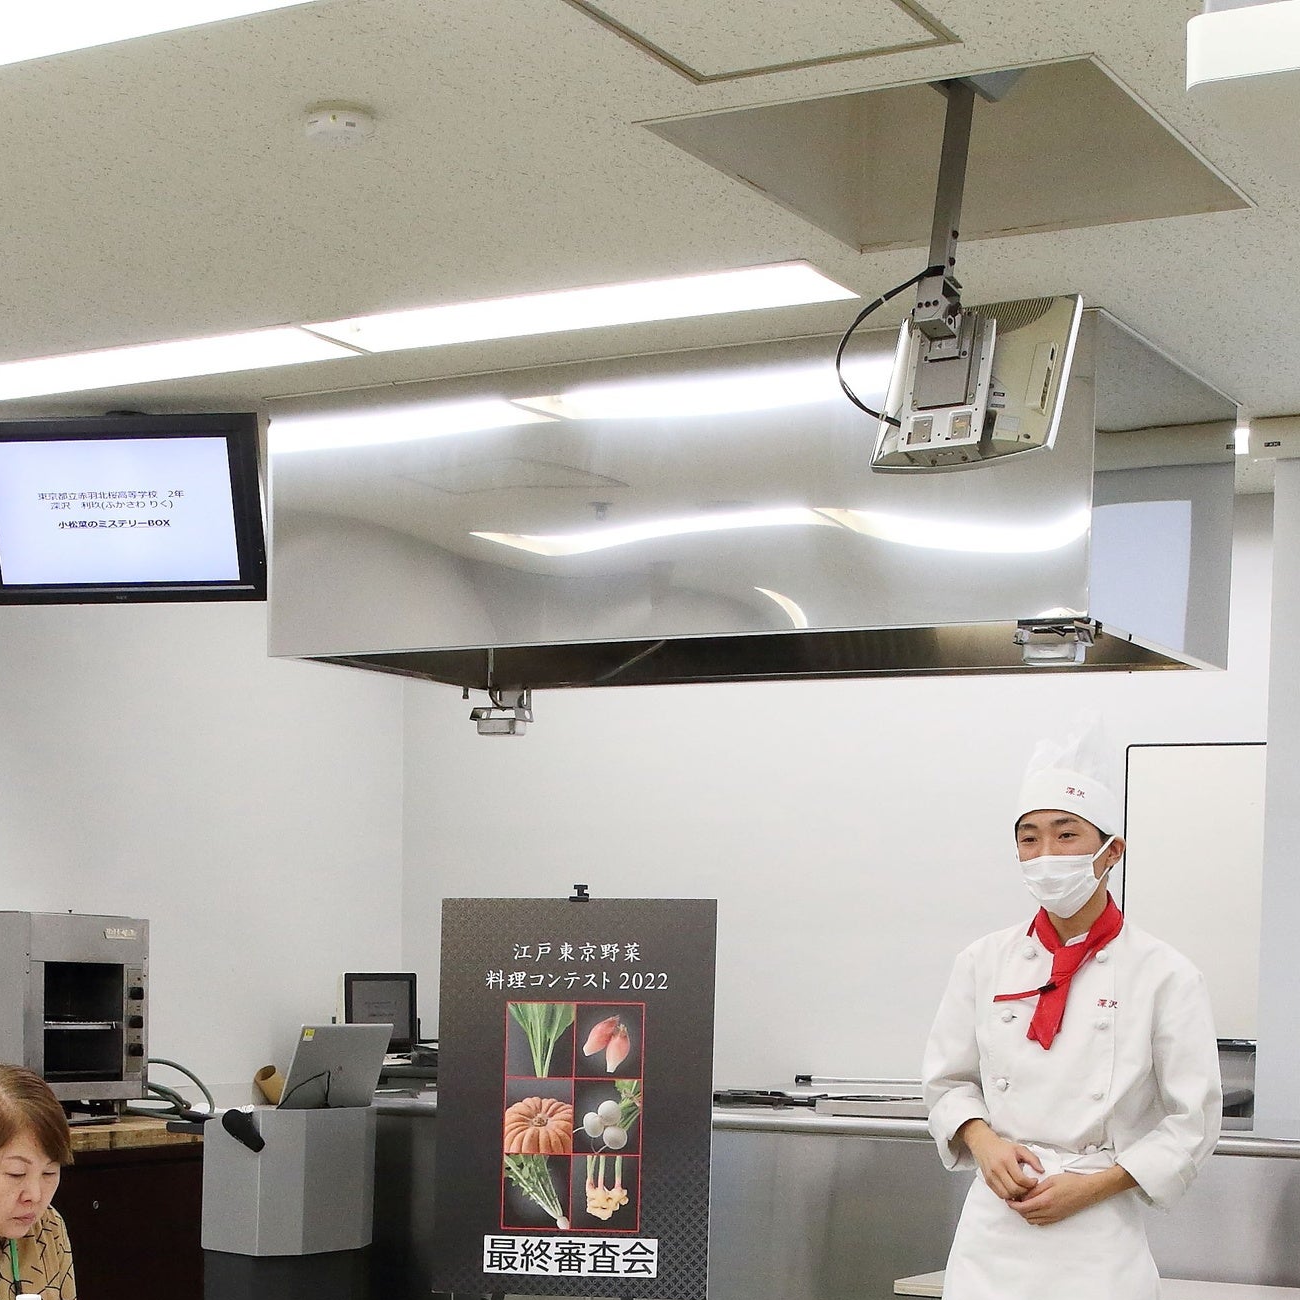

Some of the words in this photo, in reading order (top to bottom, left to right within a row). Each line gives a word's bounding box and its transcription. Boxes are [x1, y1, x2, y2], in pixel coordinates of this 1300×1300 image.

[38, 490, 158, 500] 東京都立赤羽北桜高等学校
[168, 490, 184, 498] 2年
[50, 501, 71, 510] 深沢
[149, 500, 173, 509] りく)
[58, 519, 171, 528] 小松菜のミステリーBOX
[513, 942, 641, 963] 江戸東京野菜
[485, 969, 611, 991] 料理コンテスト
[619, 972, 669, 990] 2022
[486, 1237, 657, 1276] 最終審査会
